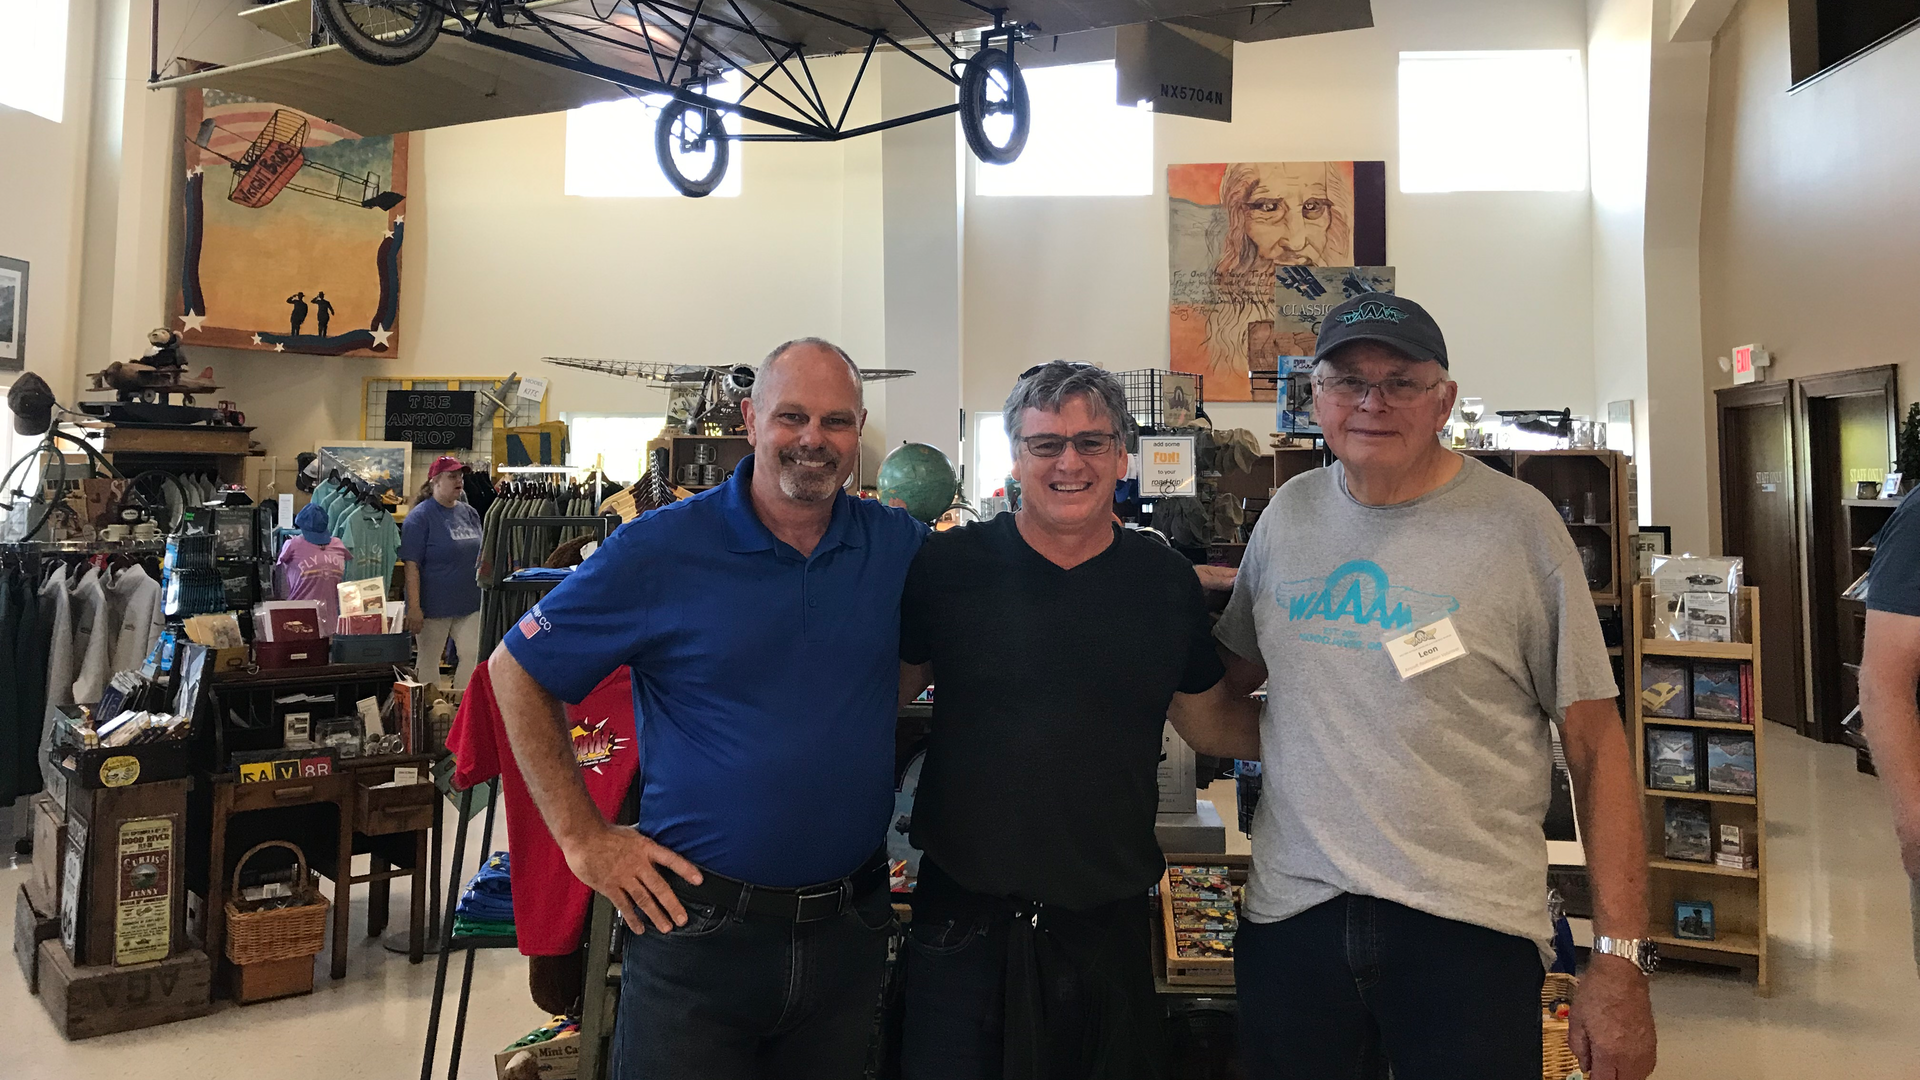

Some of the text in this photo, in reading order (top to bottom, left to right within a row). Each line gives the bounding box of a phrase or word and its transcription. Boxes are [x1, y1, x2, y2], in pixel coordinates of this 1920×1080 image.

[1160, 83, 1223, 105] NX5704N
[232, 143, 295, 204] WRIGHT BROS
[1736, 347, 1751, 373] EXIT
[524, 377, 544, 388] MODEL
[409, 394, 452, 410] THE
[386, 412, 472, 427] ANTIQUE
[401, 430, 456, 444] SHOP
[1153, 451, 1180, 464] FUN!
[1756, 471, 1782, 484] STAFF ONLY
[1849, 468, 1884, 483] STAFF ONLY
[1639, 542, 1656, 552] ER
[297, 554, 318, 576] FLY
[1288, 578, 1413, 633] WAAAM
[1418, 645, 1439, 659] Leon
[281, 767, 293, 779] V
[305, 763, 329, 777] 8R
[121, 833, 170, 846] HOOD RIVER
[128, 887, 159, 898] JENNY
[539, 1045, 580, 1058] Mini Ca
